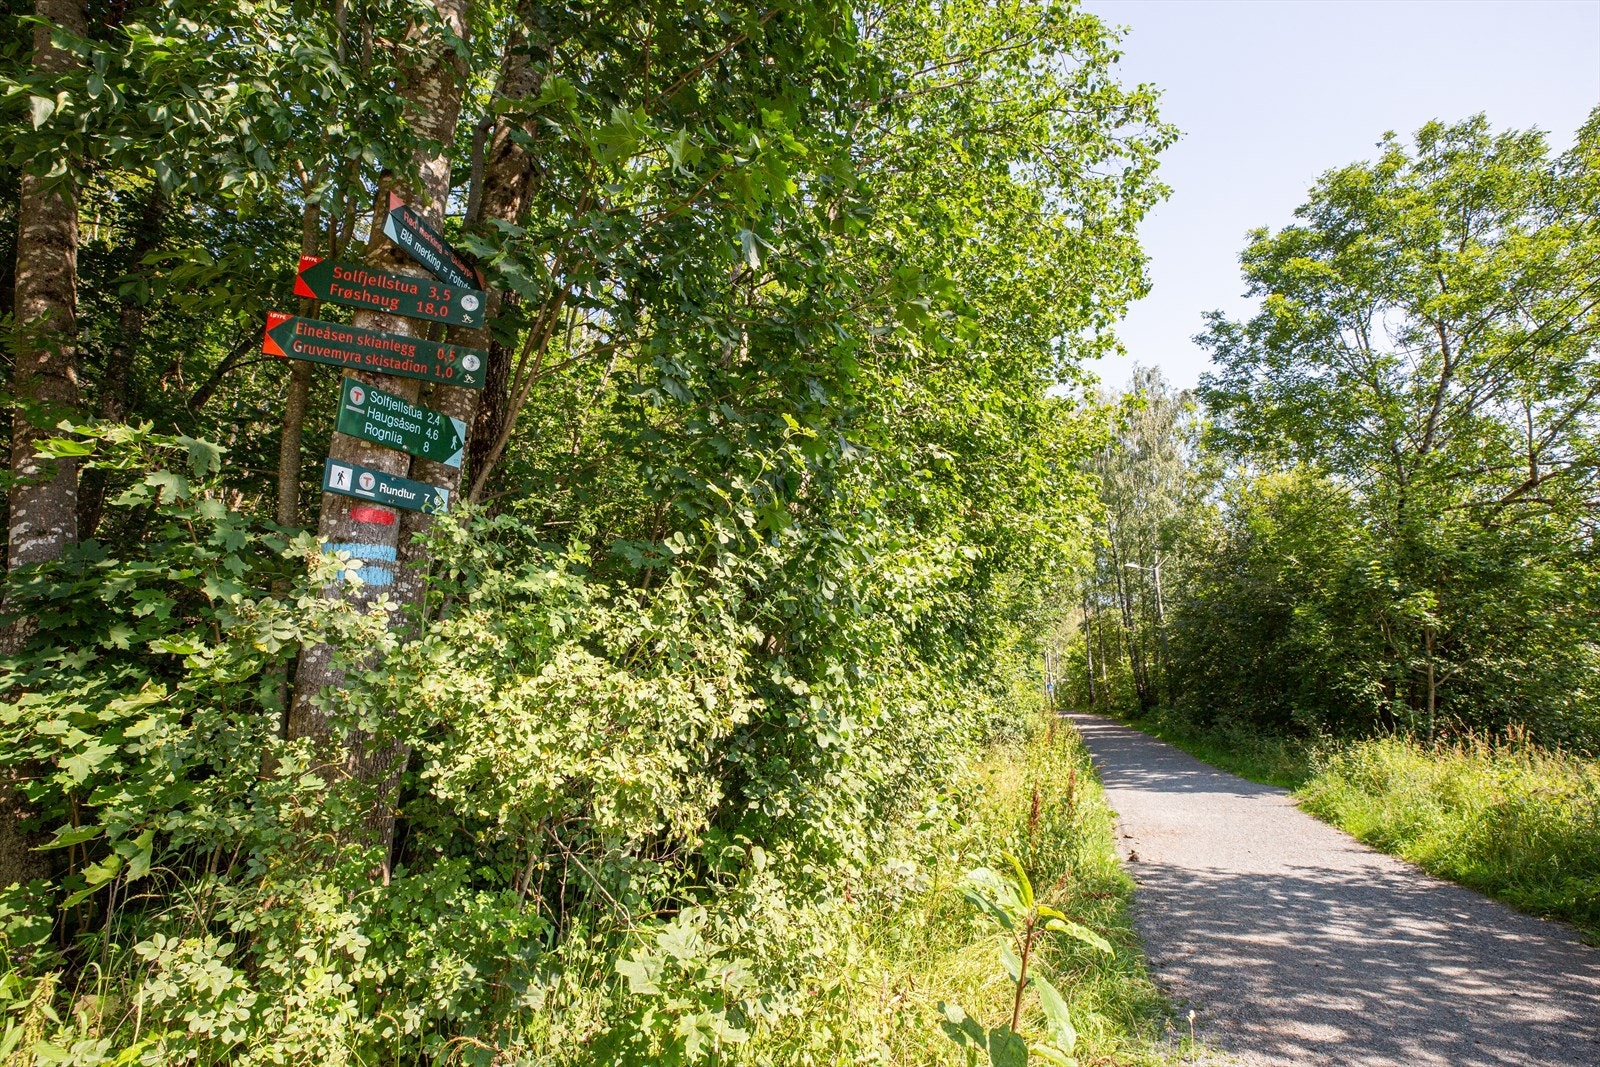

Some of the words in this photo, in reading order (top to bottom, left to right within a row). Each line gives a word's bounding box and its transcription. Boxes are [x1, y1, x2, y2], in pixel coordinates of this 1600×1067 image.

[400, 228, 412, 246] Blå
[414, 242, 441, 271] merking
[419, 227, 442, 254] merking
[330, 283, 400, 311] Frøshaug
[416, 301, 449, 318] 18,0
[332, 266, 418, 295] Solfjellstua
[428, 286, 451, 302] 3,5
[295, 322, 353, 344] Eineåsen
[357, 330, 416, 357] skianlegg
[437, 348, 456, 362] 0,5
[293, 340, 362, 367] Gruvemyra
[365, 353, 428, 374] skistadion
[434, 364, 453, 378] 1,0
[367, 406, 421, 434] Haugsåsen
[369, 391, 423, 420] Solfjellstua
[364, 422, 403, 445] Rognlia
[423, 441, 430, 453] 8
[379, 483, 416, 500] Rundtur
[424, 493, 430, 502] 7
